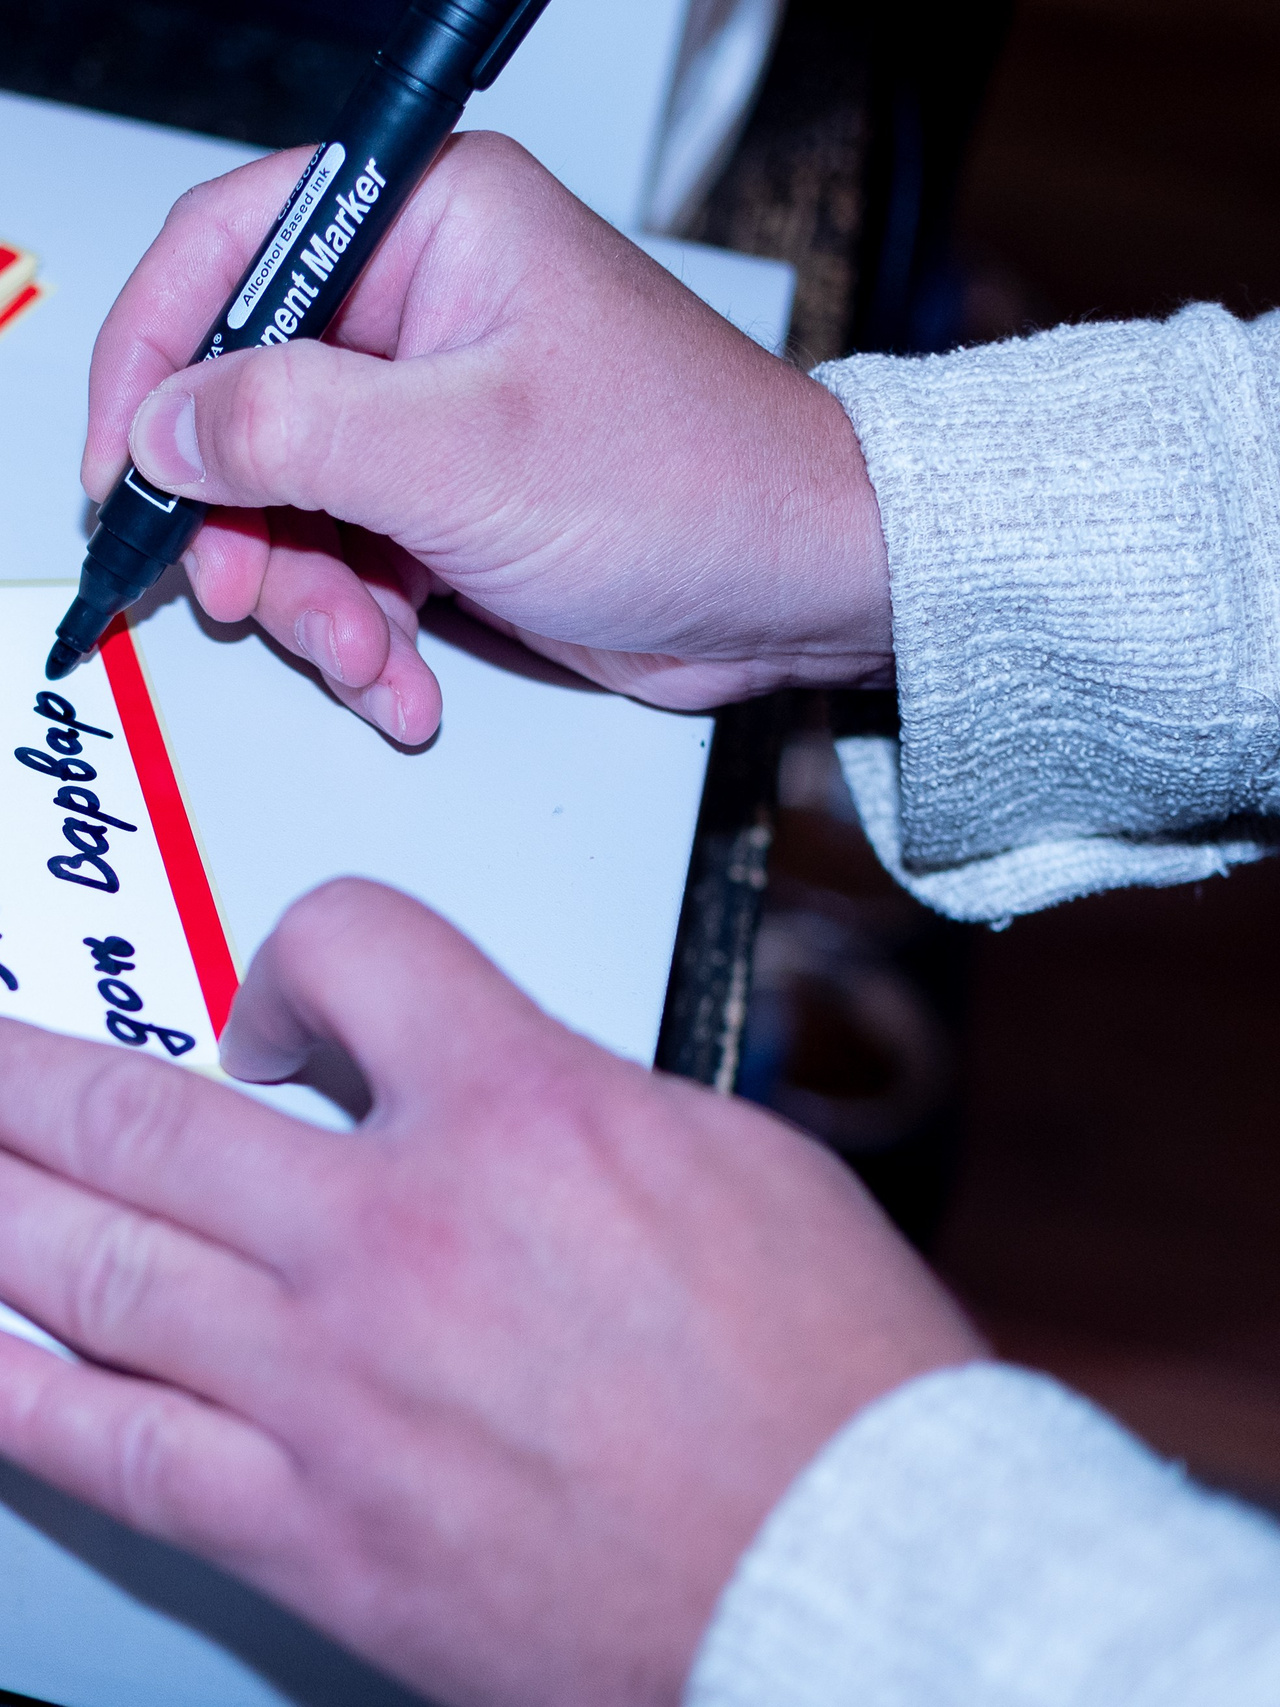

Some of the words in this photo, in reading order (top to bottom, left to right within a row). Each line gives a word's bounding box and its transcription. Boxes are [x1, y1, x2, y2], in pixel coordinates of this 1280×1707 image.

[242, 242, 283, 307] Allcohol
[280, 193, 314, 242] Based
[310, 167, 331, 193] ink
[254, 270, 319, 349] nent
[299, 157, 387, 283] Marker
[13, 690, 139, 894] Варвар
